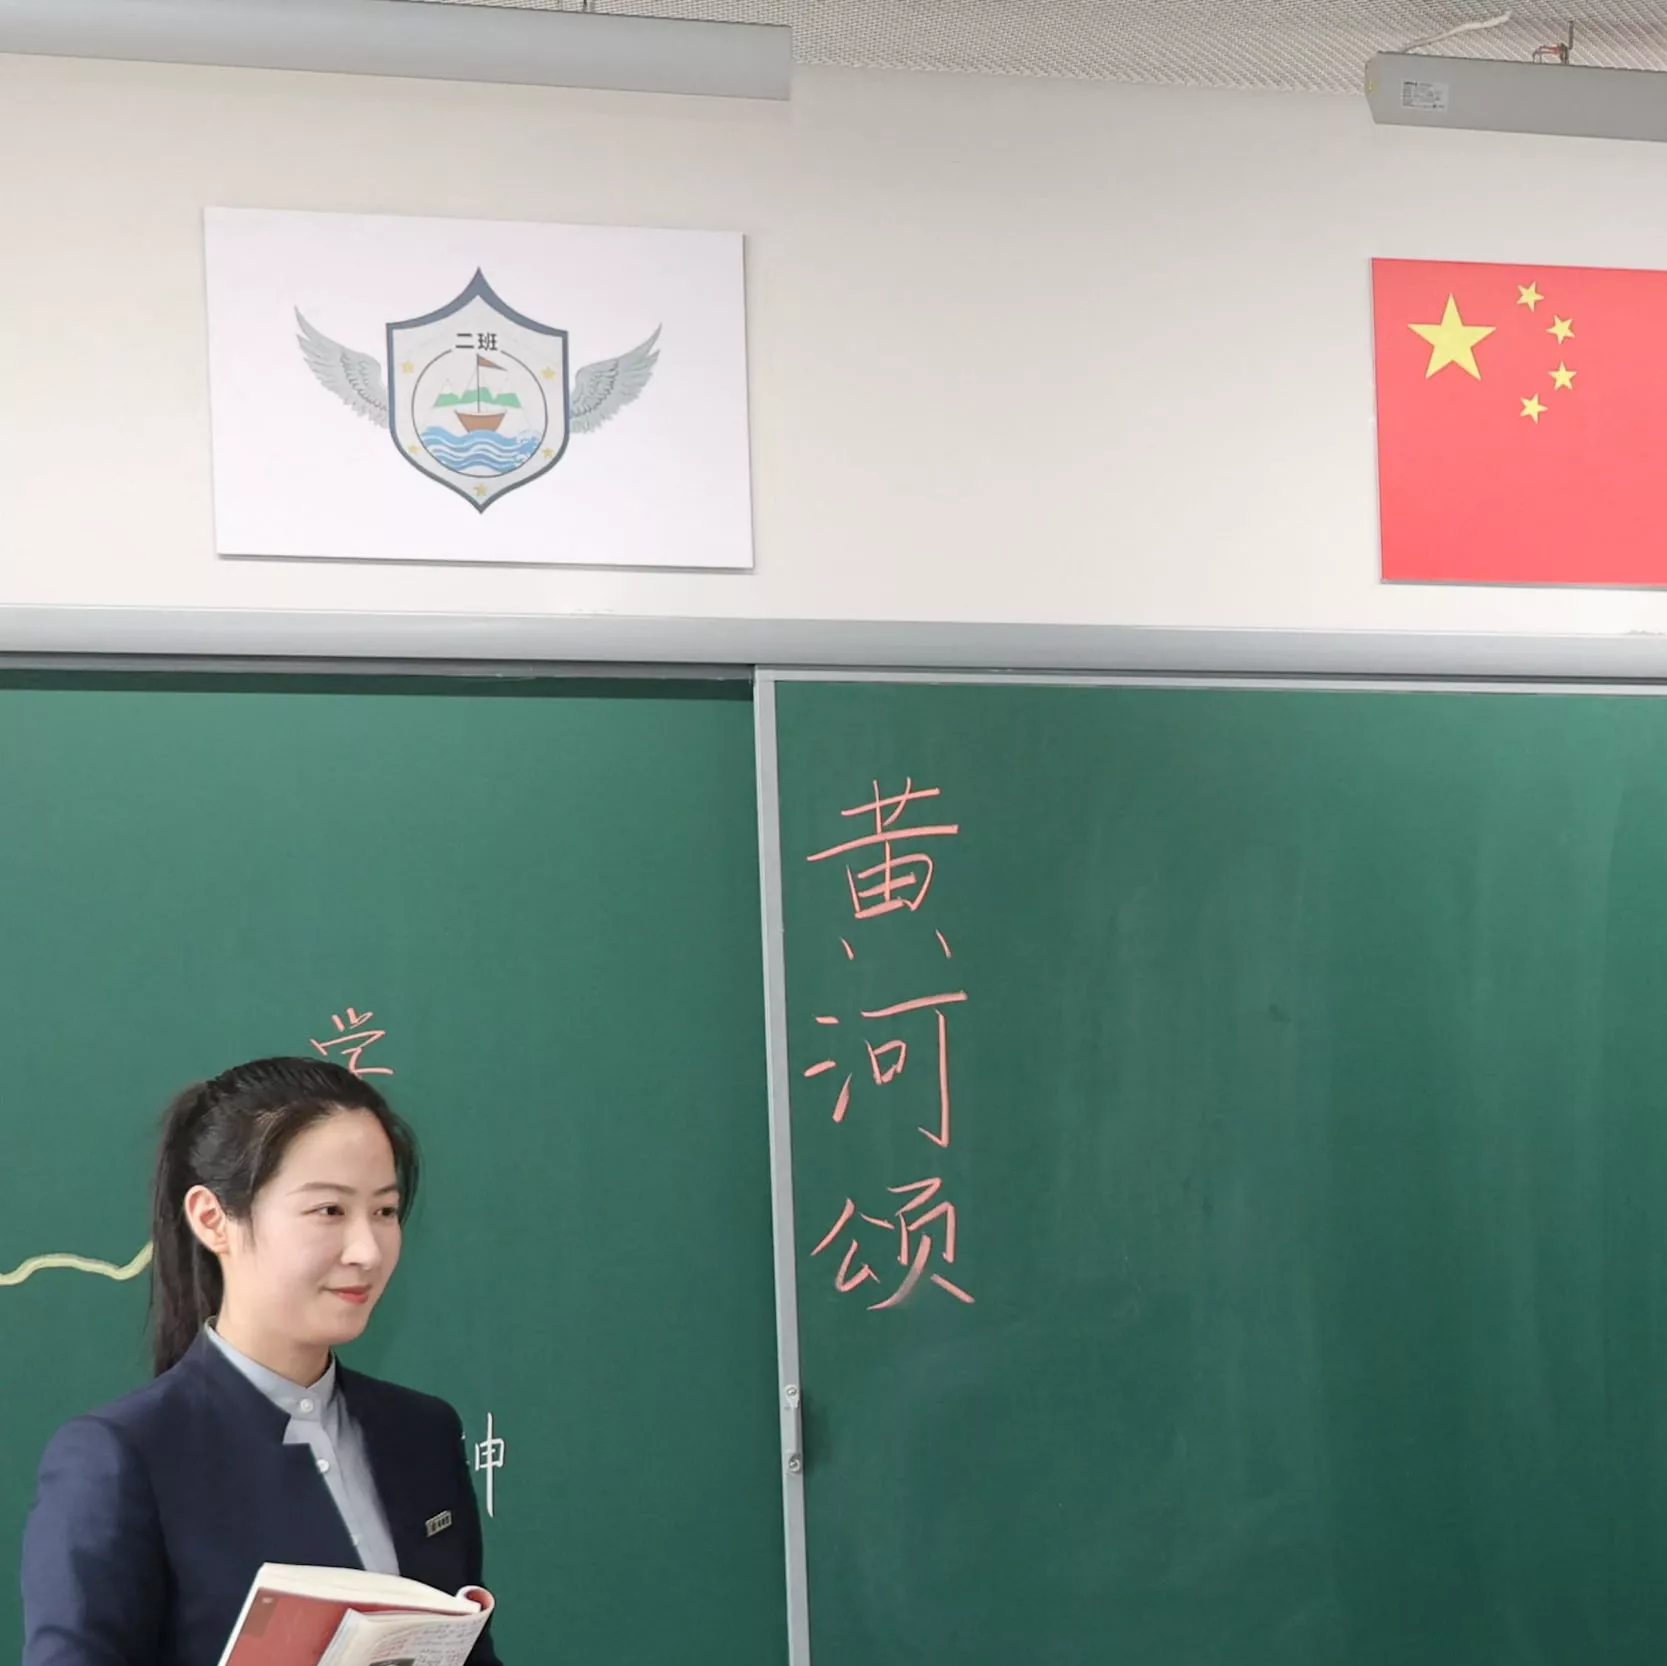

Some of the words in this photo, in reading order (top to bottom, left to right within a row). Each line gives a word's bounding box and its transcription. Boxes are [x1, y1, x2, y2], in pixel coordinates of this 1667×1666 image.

[455, 332, 498, 351] 二班
[803, 776, 976, 1311] 黄河颂
